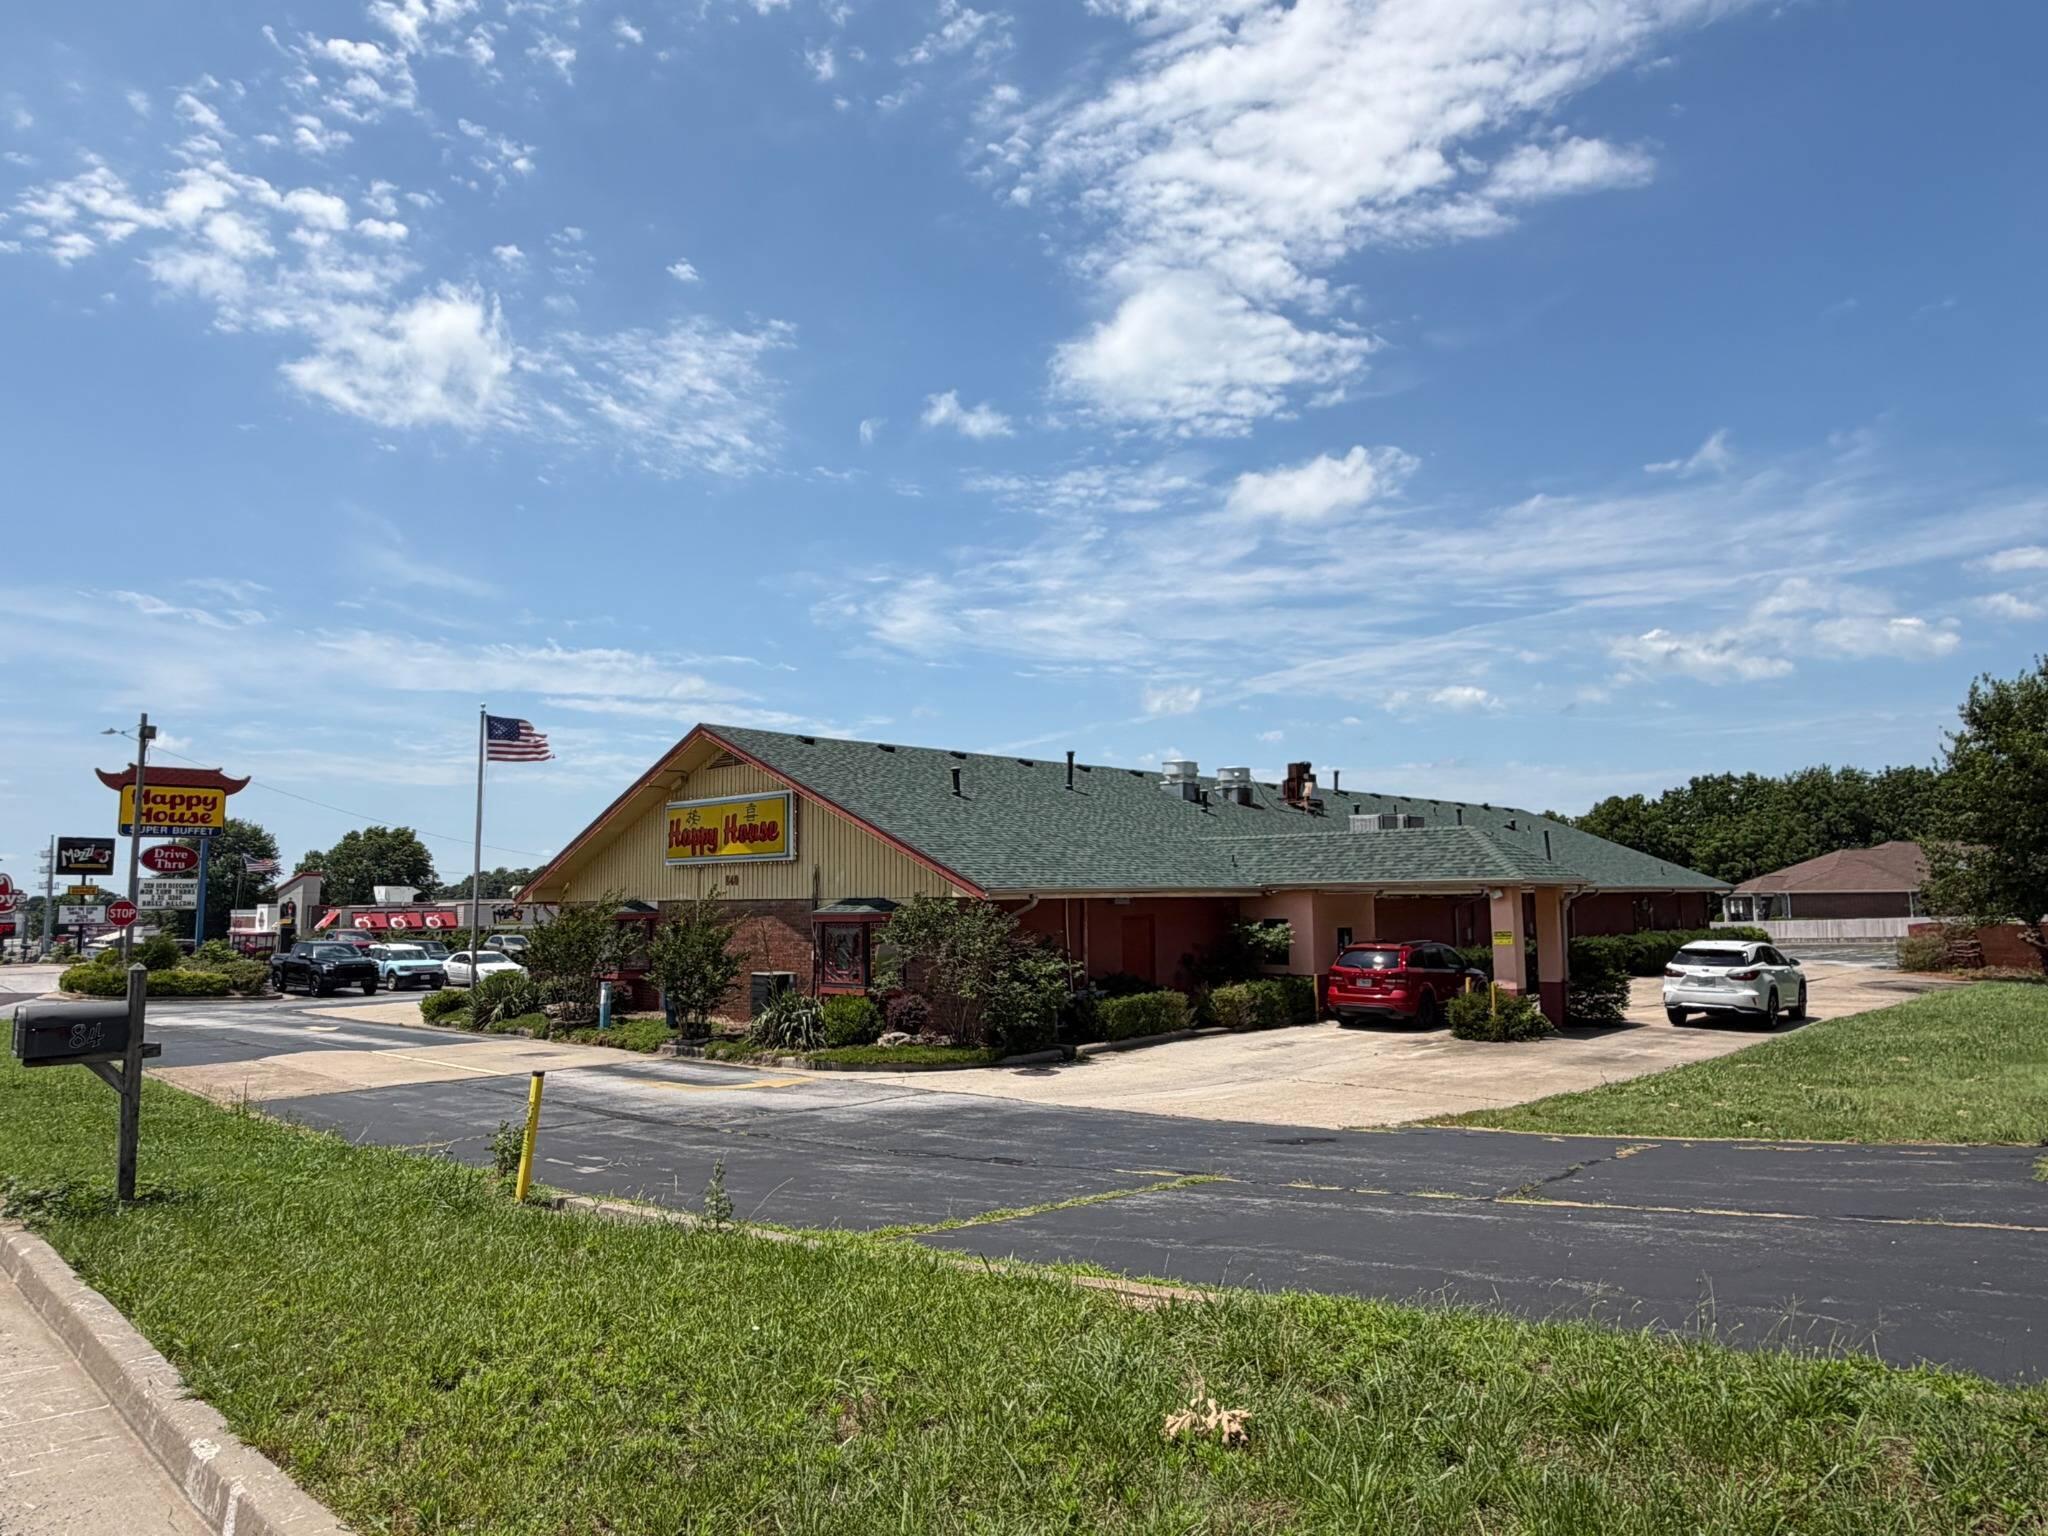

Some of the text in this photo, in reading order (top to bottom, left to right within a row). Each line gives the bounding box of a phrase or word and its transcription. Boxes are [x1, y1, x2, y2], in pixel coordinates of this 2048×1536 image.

[131, 789, 218, 811] Happy
[172, 826, 214, 836] BUFFET
[668, 818, 719, 857] Happy
[723, 813, 780, 846] House
[153, 848, 188, 859] Drive
[154, 859, 186, 869] Thru
[109, 908, 136, 919] STOP
